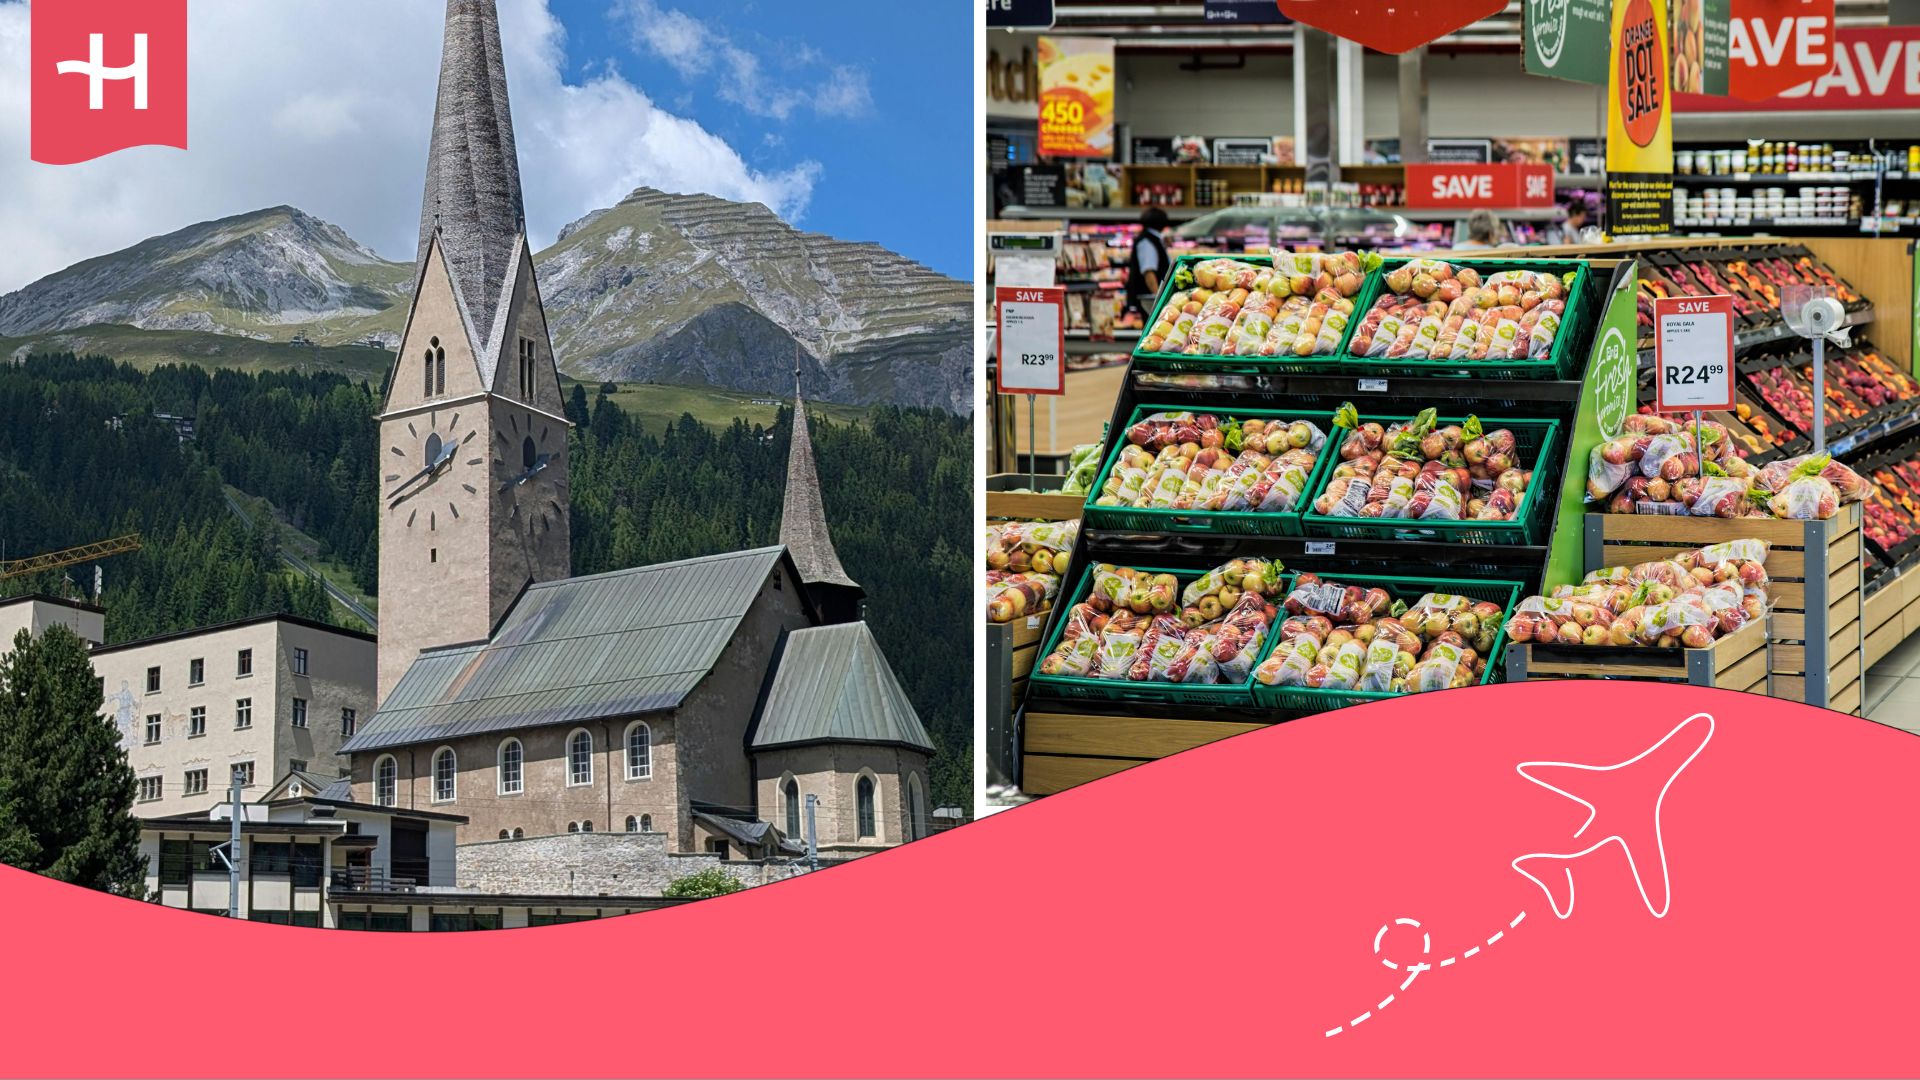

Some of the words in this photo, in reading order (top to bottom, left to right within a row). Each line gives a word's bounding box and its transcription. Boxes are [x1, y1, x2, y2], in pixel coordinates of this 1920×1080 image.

[1625, 17, 1654, 48] ORANGE
[1626, 41, 1655, 86] DOT
[1041, 101, 1083, 124] 450
[1627, 79, 1658, 122] SALE
[1432, 174, 1493, 199] SAVE
[1016, 291, 1044, 302] SAVE
[1678, 302, 1710, 314] SAVE
[1592, 339, 1632, 402] Fresh
